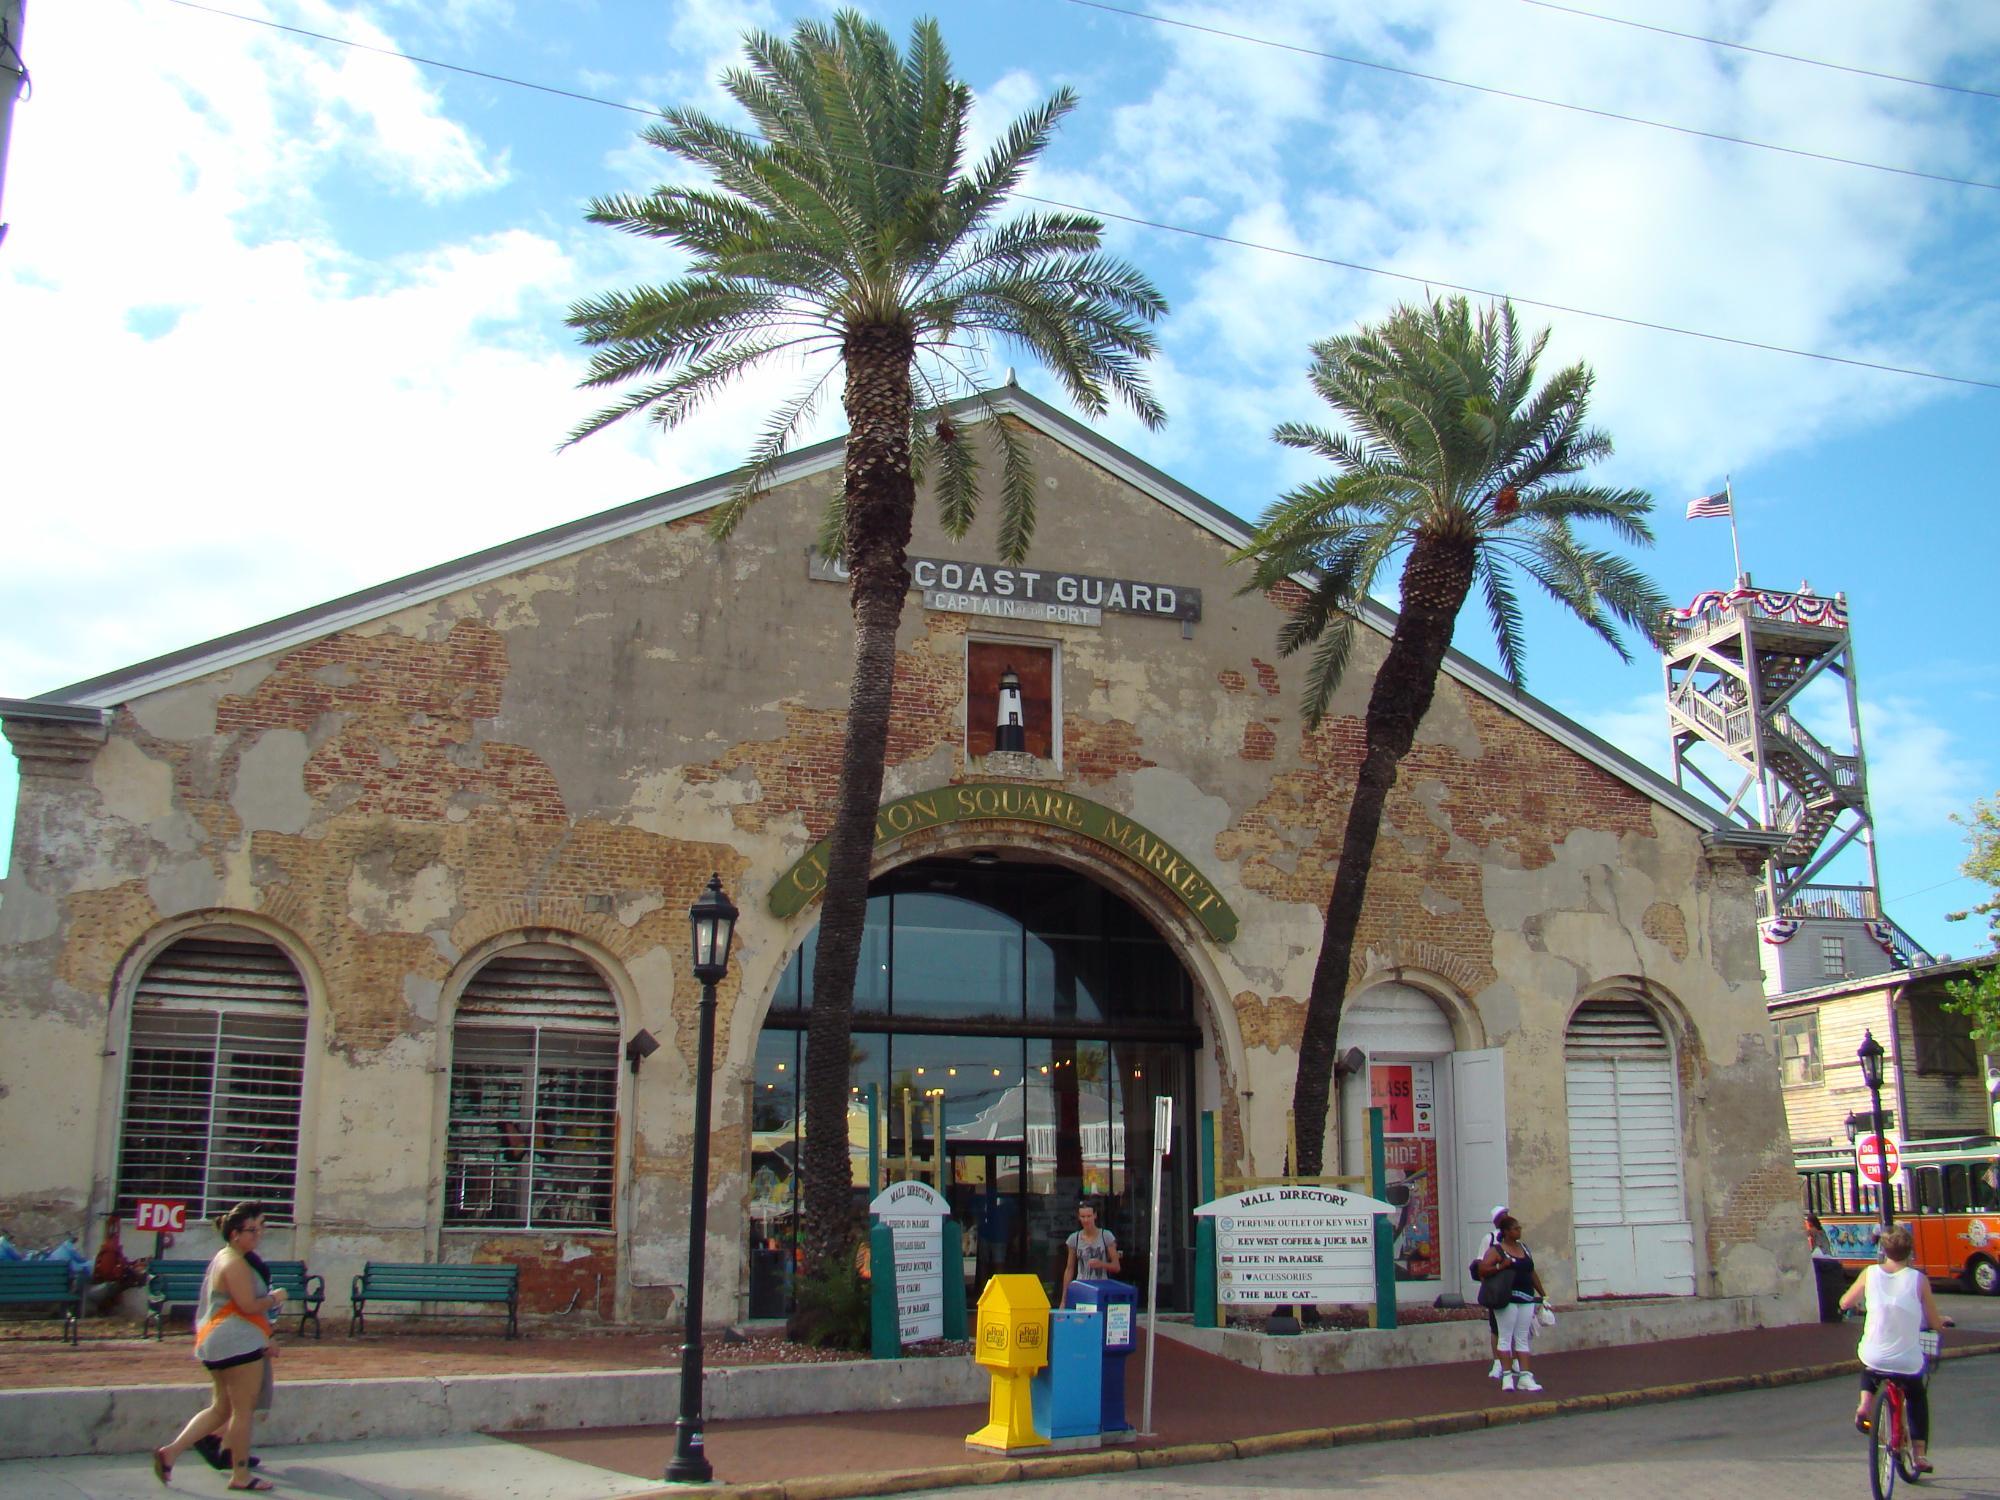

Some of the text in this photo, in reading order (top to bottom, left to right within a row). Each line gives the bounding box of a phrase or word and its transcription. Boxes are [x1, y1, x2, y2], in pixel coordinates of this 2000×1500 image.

[914, 560, 1177, 614] COAST GUARD
[934, 593, 1015, 616] CAPTAIN
[1046, 605, 1090, 624] PORT
[792, 787, 1222, 912] CLTON SQUARE MARKET
[1862, 1144, 1873, 1153] DO
[1239, 1190, 1348, 1208] MALL DIRECTORY
[138, 1202, 185, 1229] FDC
[1237, 1218, 1369, 1228] PERFUME OUTLET OF KEY WEST
[1238, 1236, 1368, 1247] KEY WEST COFFEE & JUICE BAR
[1238, 1255, 1324, 1263] LIFE IN PARADISE
[1252, 1272, 1313, 1281] ACCESSORIES
[1239, 1291, 1260, 1299] THE
[1263, 1291, 1288, 1299] BLUE
